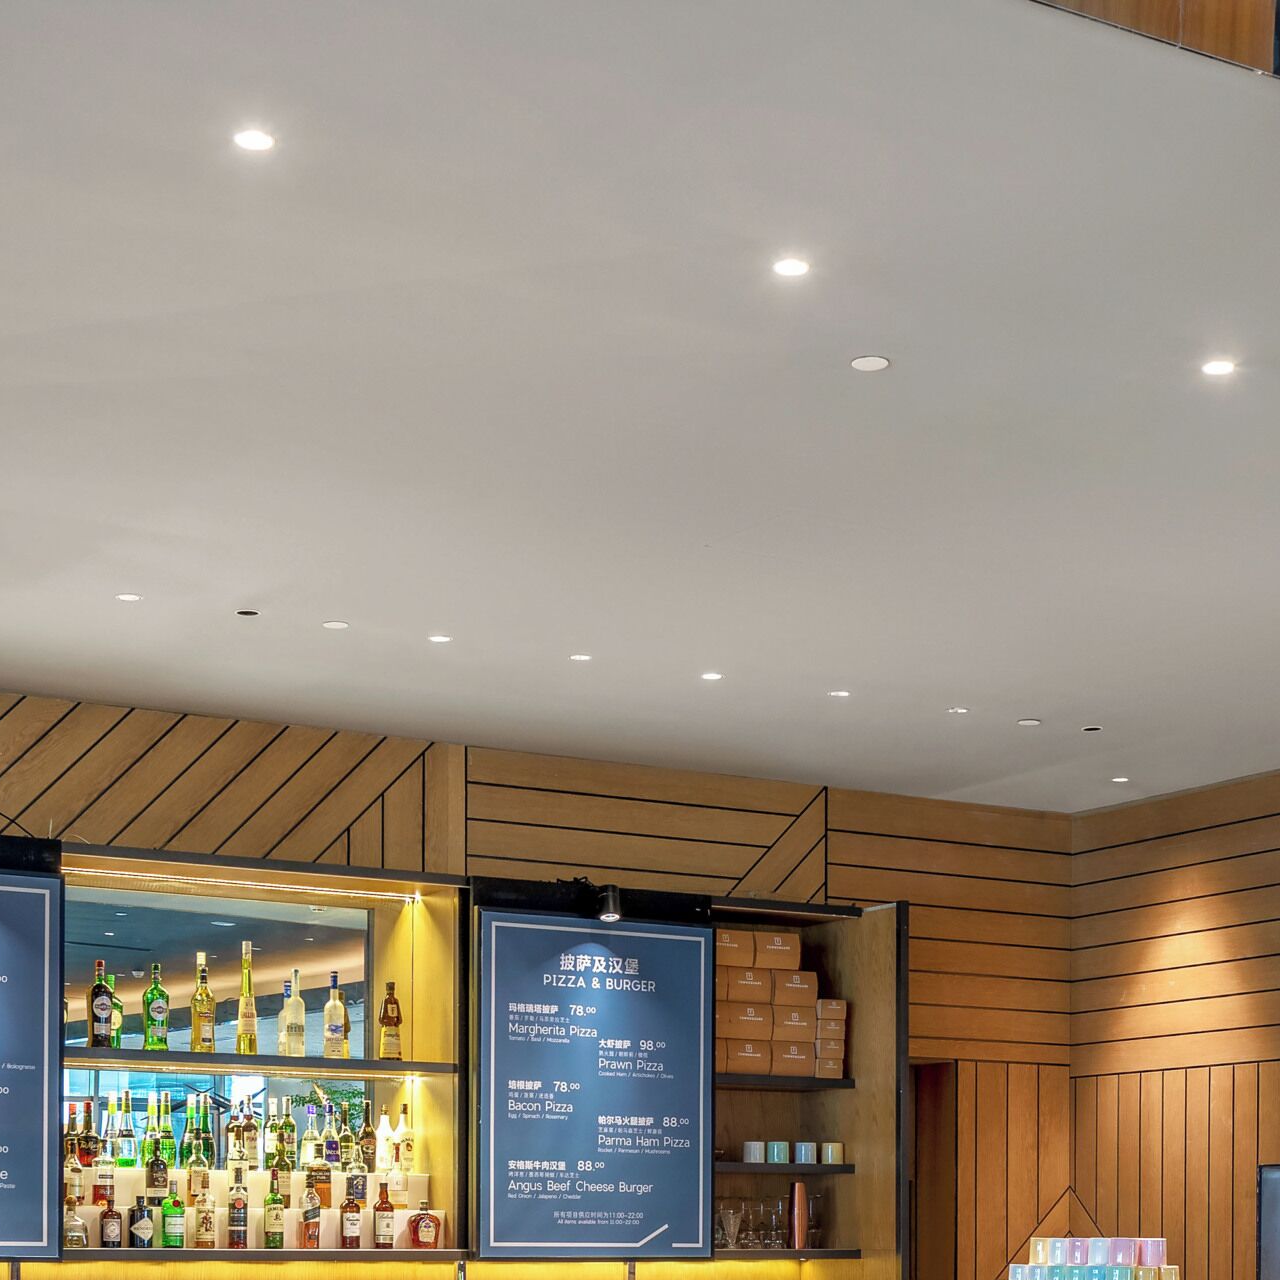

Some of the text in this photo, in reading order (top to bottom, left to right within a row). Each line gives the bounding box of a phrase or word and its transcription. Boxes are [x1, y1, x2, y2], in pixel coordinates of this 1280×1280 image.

[560, 953, 639, 975] 披萨及汉堡
[543, 974, 656, 992] PIZZA & BURGER
[569, 1004, 597, 1016] 78.00
[509, 1022, 597, 1037] Margherita Pizza
[598, 1039, 666, 1051] 大虾披萨 98.00
[598, 1058, 663, 1071] Prawn Pizza
[508, 1080, 580, 1092] 培根披萨 78.00
[508, 1100, 573, 1113] Bacon Pizza
[598, 1115, 689, 1127] 帕尔马火腿披萨 88.00
[598, 1135, 690, 1148] Parma Ham Pizza
[508, 1160, 605, 1171] 安格斯牛肉汉堡 88.00
[508, 1180, 654, 1195] Angus Beef Cheese Burger
